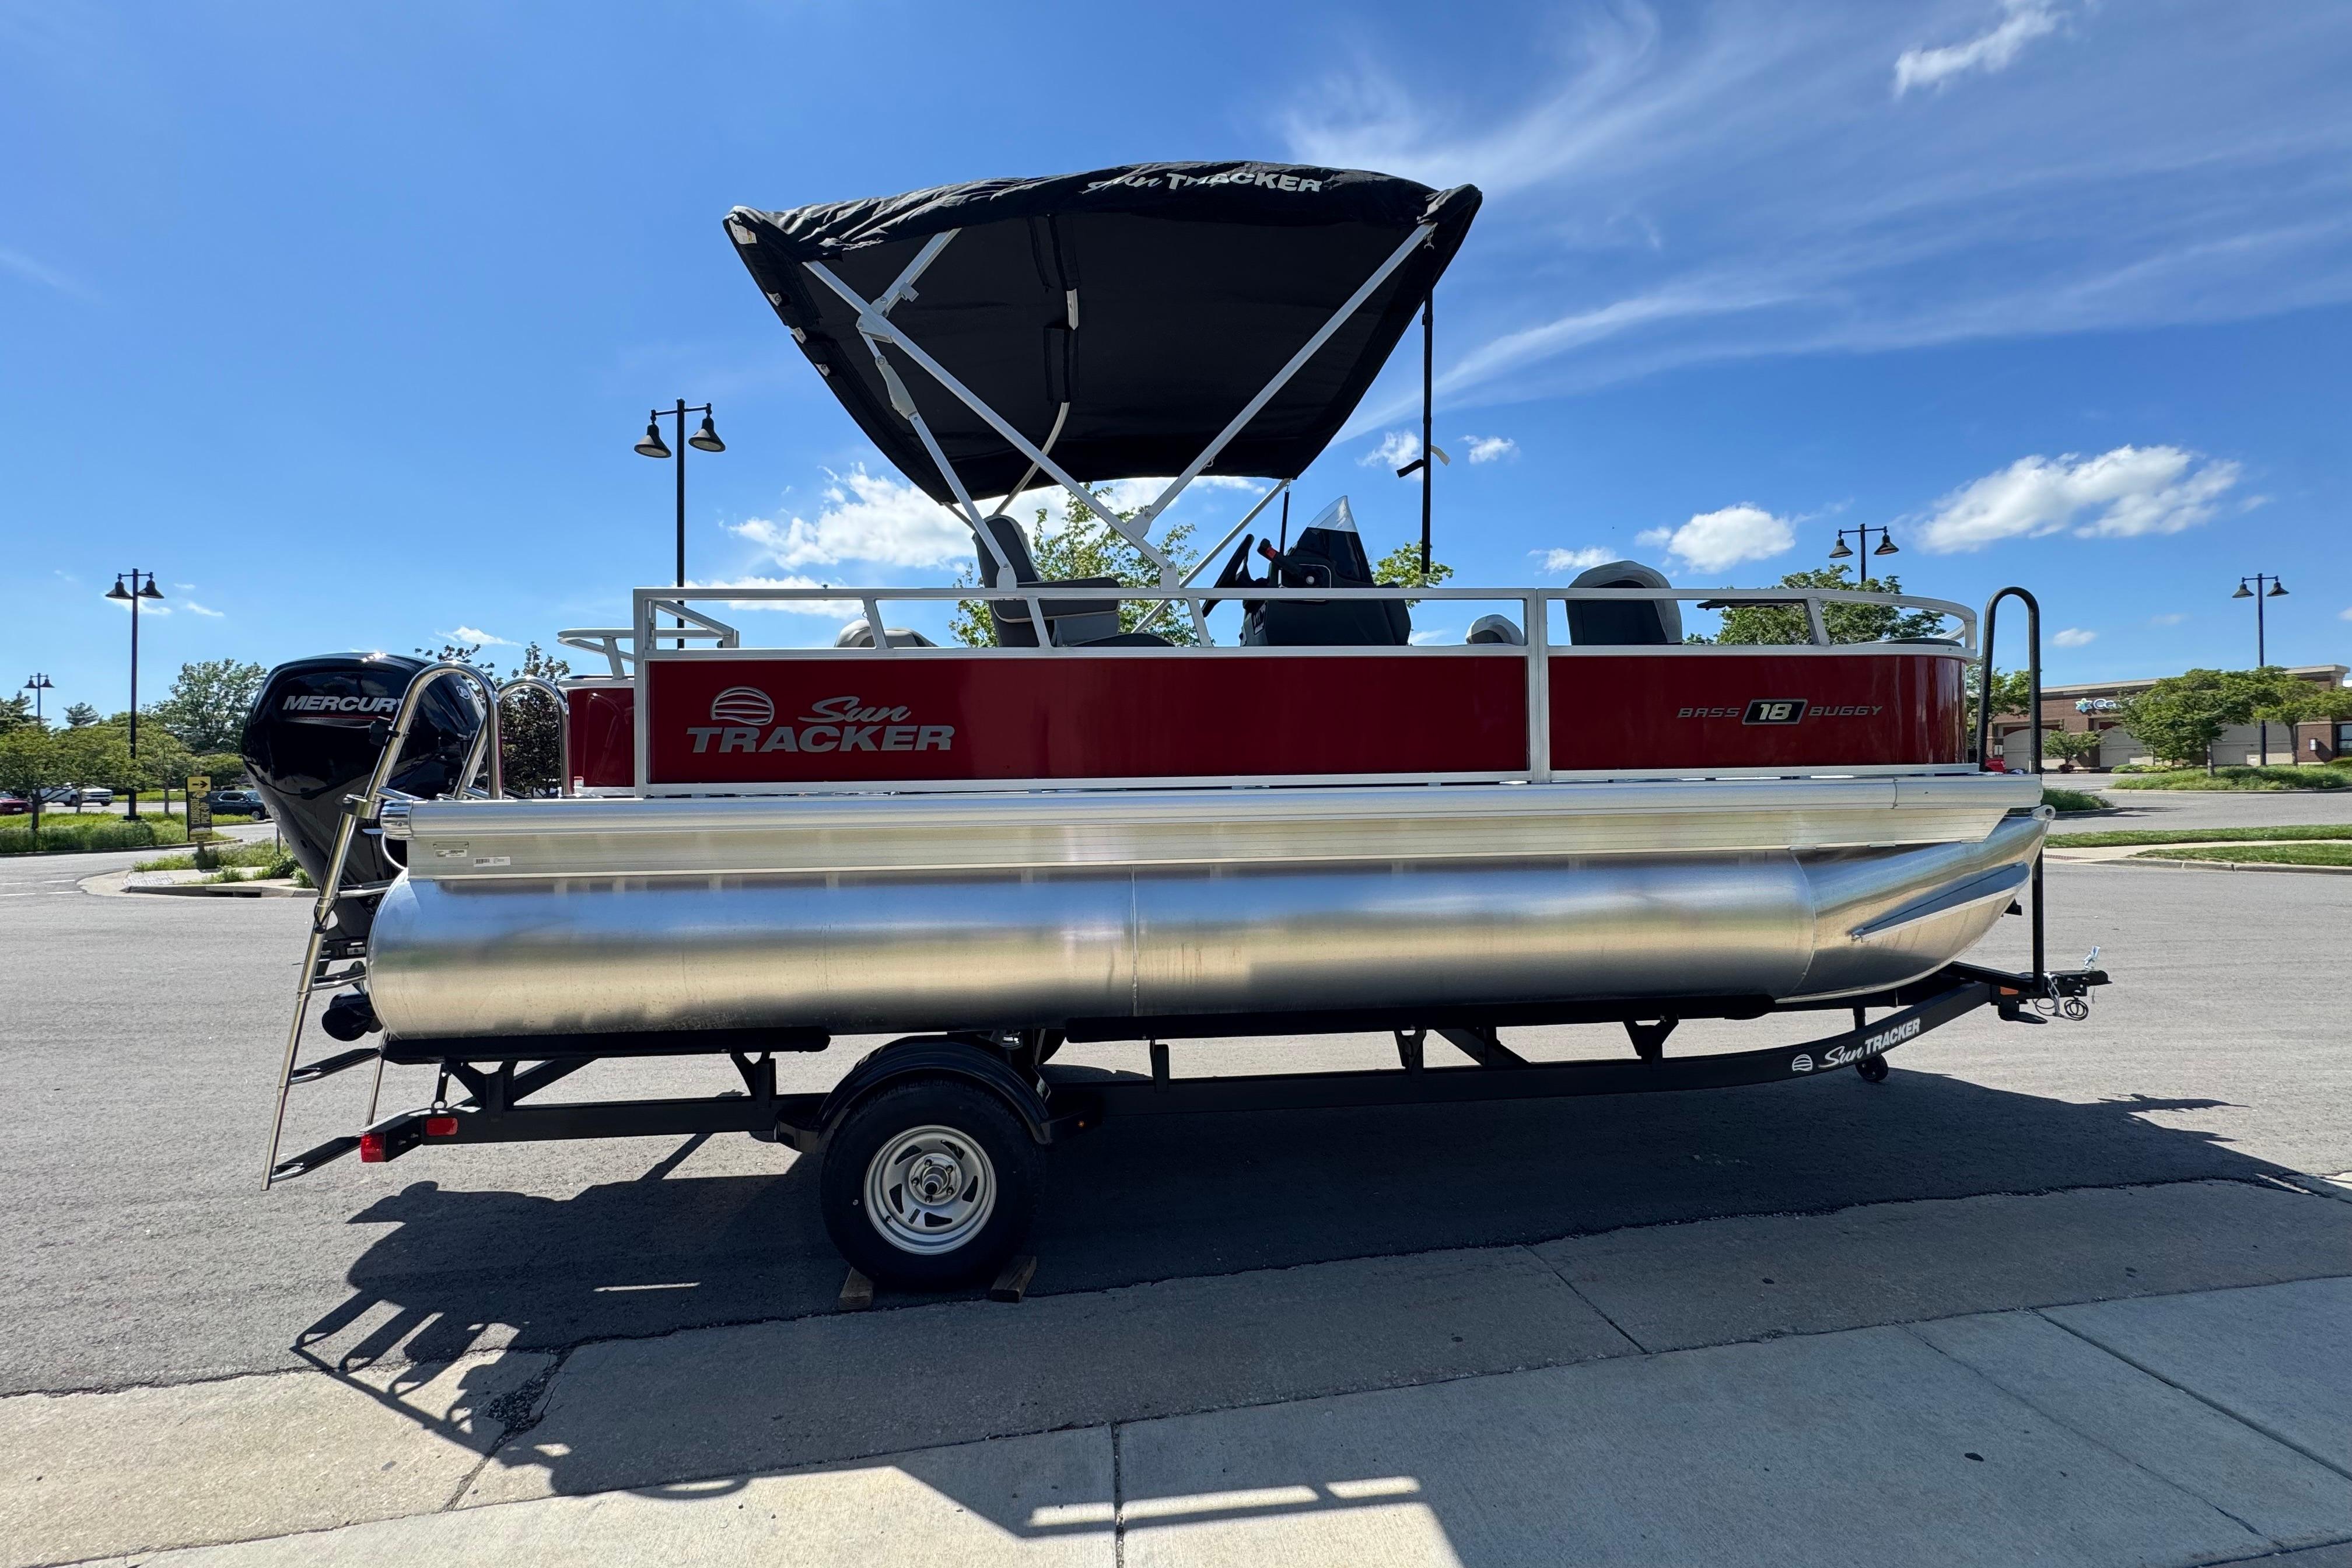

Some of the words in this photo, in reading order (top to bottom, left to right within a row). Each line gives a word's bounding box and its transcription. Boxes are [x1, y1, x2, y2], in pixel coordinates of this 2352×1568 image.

[798, 696, 911, 722] Sun
[1677, 708, 1741, 718] BASS
[1759, 704, 1792, 720] 18
[1808, 706, 1883, 716] BUGGY
[687, 726, 955, 752] TRACKER
[1818, 1046, 1864, 1069] Sun
[1865, 1018, 1921, 1054] TRACKER
